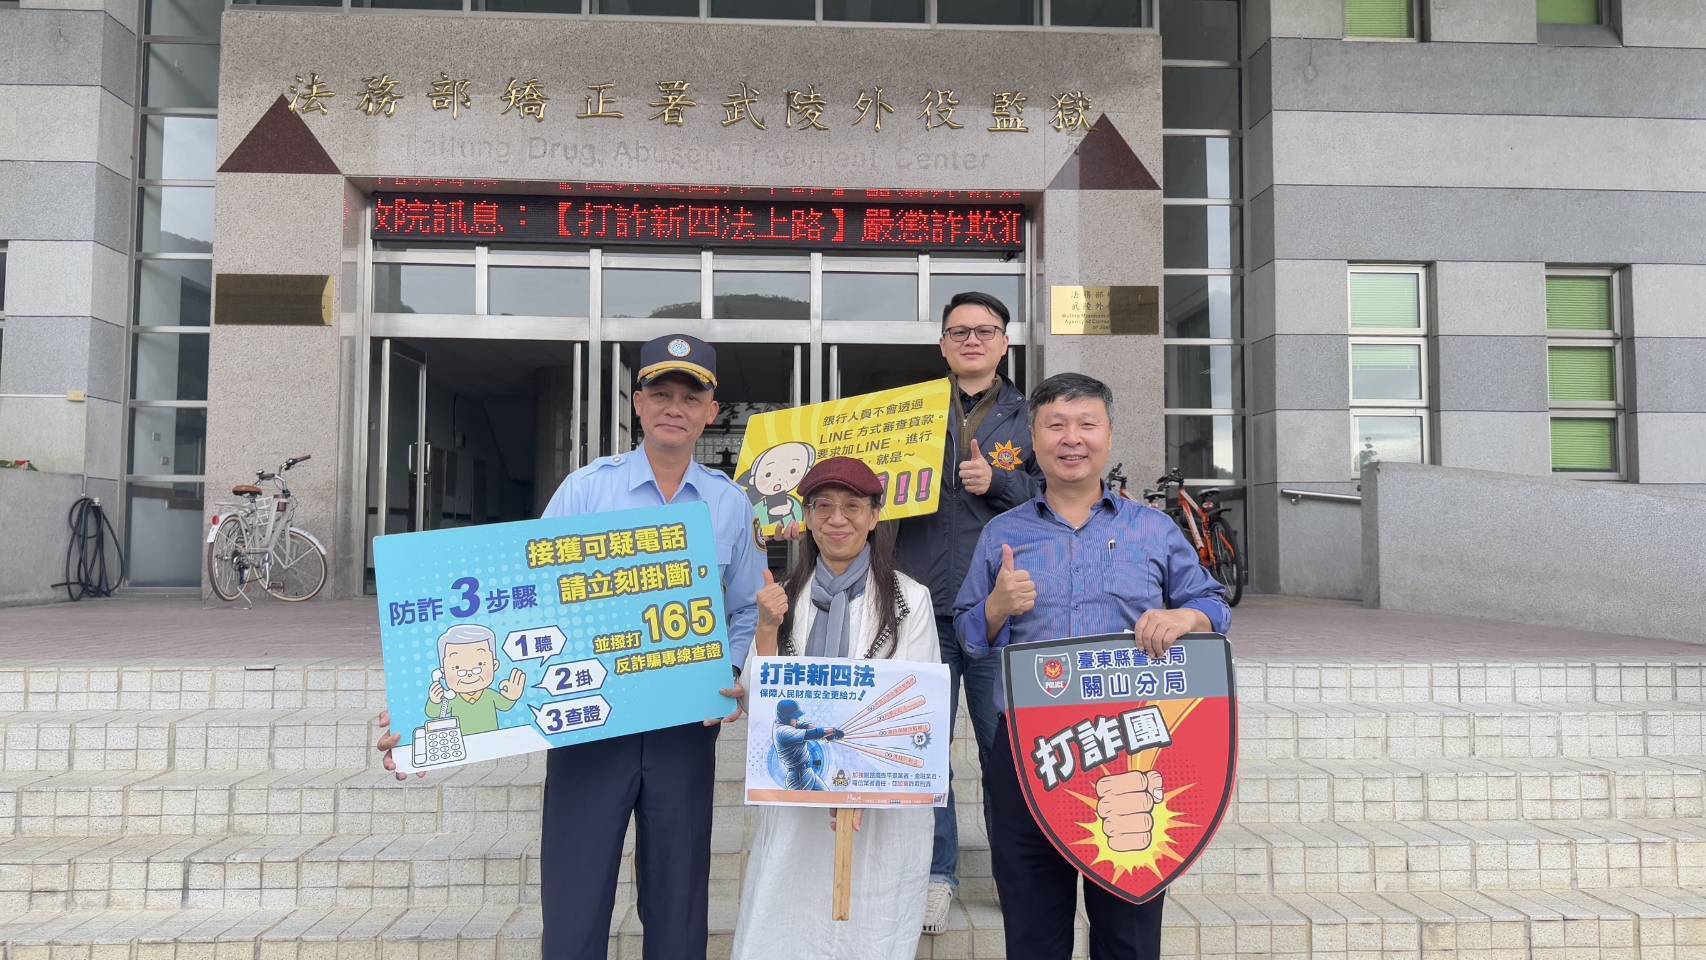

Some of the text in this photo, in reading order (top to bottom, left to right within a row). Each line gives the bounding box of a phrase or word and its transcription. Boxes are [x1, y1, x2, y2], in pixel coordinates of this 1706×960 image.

[288, 73, 1098, 132] 法務部矯正署武陵外役監獄
[823, 399, 923, 426] 銀行人員不會透過
[526, 522, 688, 569] 接獲可疑電話
[615, 641, 723, 675] 反詐騙專線查證
[760, 662, 875, 687] 打詐新四法
[1045, 680, 1065, 689] POLICE
[1080, 669, 1187, 699] 關山分局
[1033, 705, 1173, 789] 打詐團
